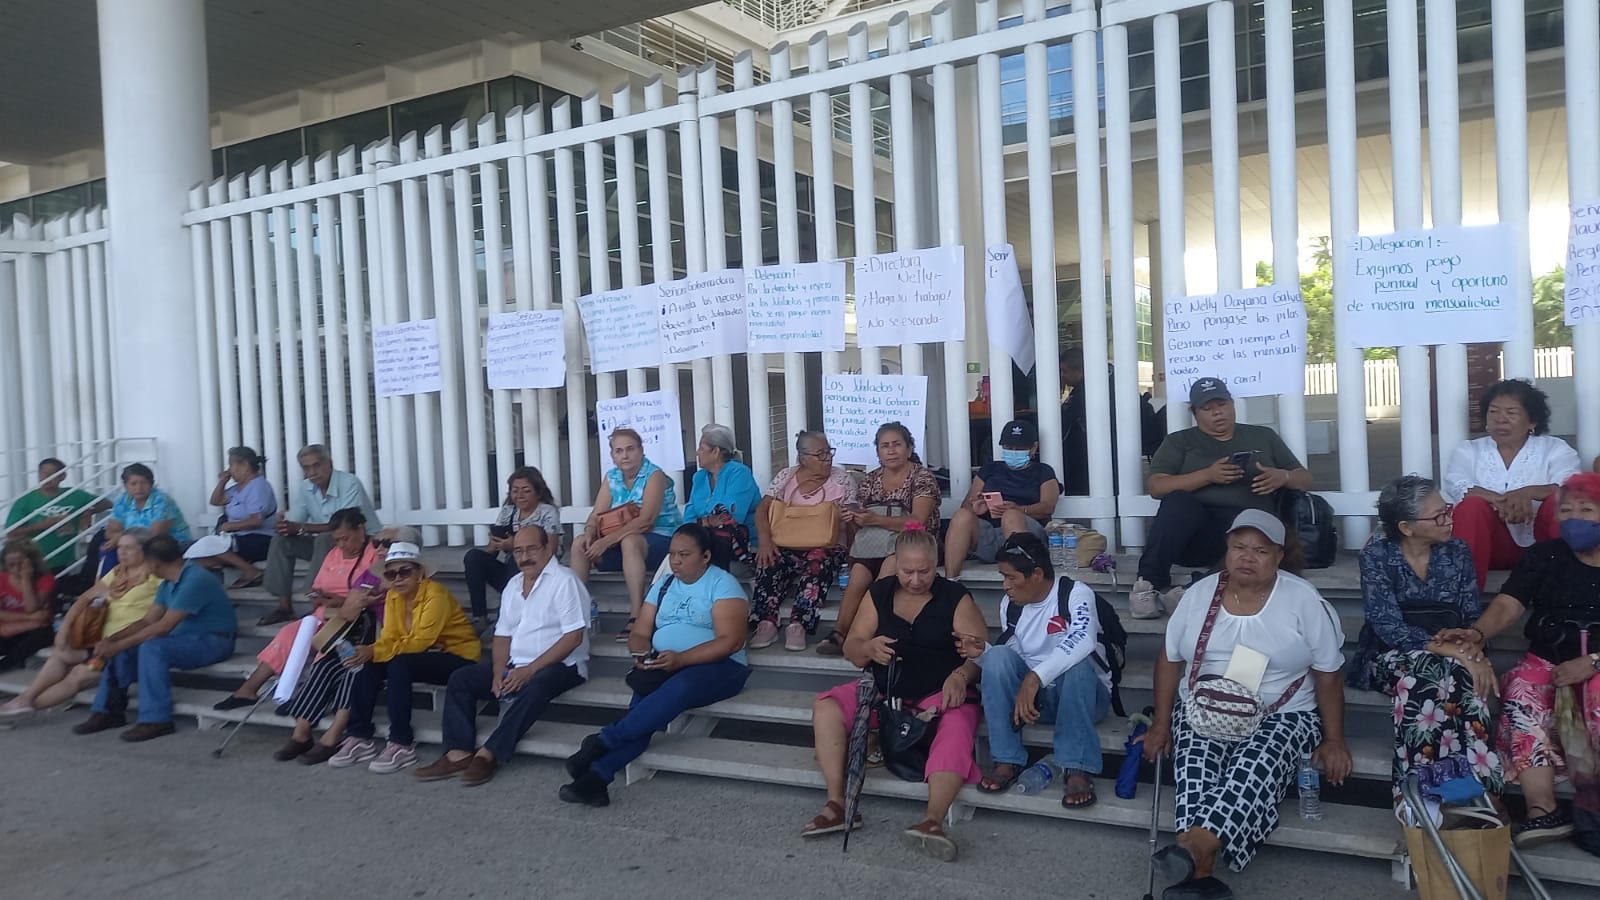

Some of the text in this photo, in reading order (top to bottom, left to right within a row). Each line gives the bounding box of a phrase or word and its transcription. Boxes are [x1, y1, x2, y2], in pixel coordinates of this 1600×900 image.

[1356, 255, 1462, 279] Exigimos pago
[1375, 274, 1508, 294] puntual y oportuno
[1190, 297, 1217, 313] Nelly
[1224, 294, 1267, 312] Dayana
[1347, 295, 1501, 312] de nuestra mensualidad
[1168, 318, 1190, 331] Pino
[1256, 312, 1270, 323] las
[1277, 307, 1299, 323] pilas
[1168, 330, 1290, 351] Gestione con tiempo el
[1169, 353, 1206, 365] recurso
[1212, 350, 1225, 361] de
[1233, 348, 1247, 360] las
[825, 376, 905, 397] Los Jubilados y
